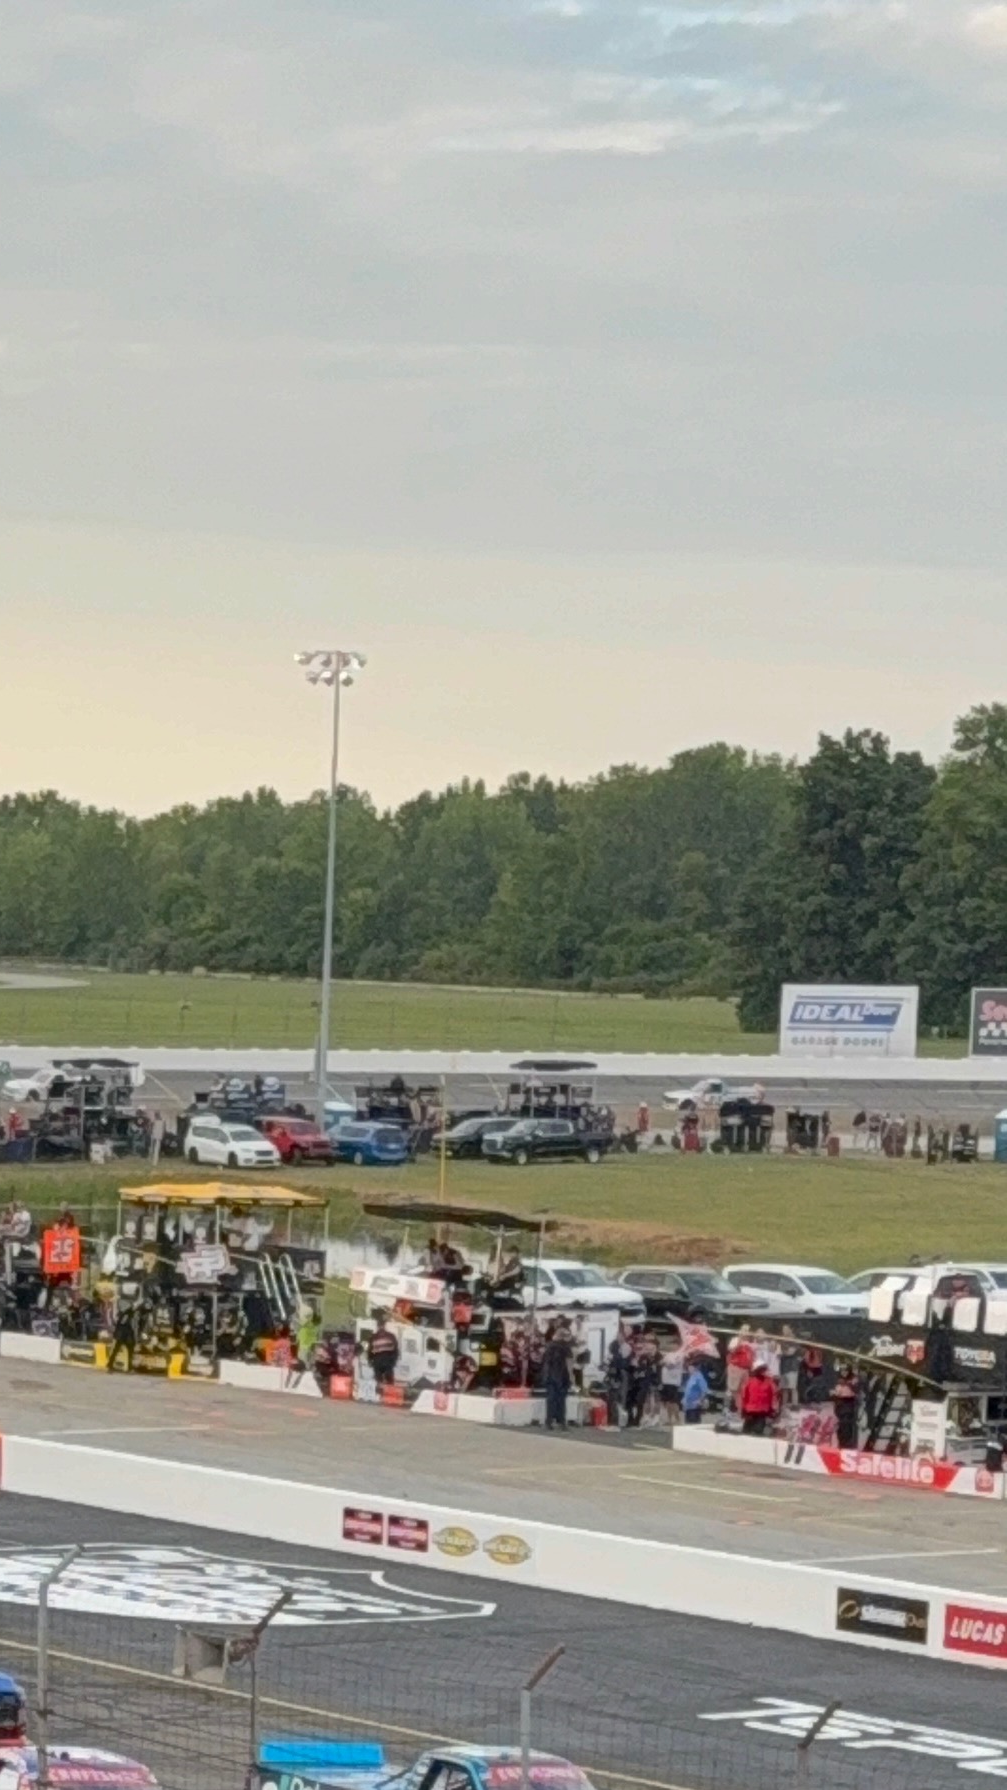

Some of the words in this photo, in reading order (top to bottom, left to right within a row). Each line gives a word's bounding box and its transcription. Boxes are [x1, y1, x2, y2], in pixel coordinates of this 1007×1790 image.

[793, 1004, 864, 1021] IDEAL
[840, 1449, 935, 1484] Safelite
[949, 1616, 1006, 1646] LUCAS
